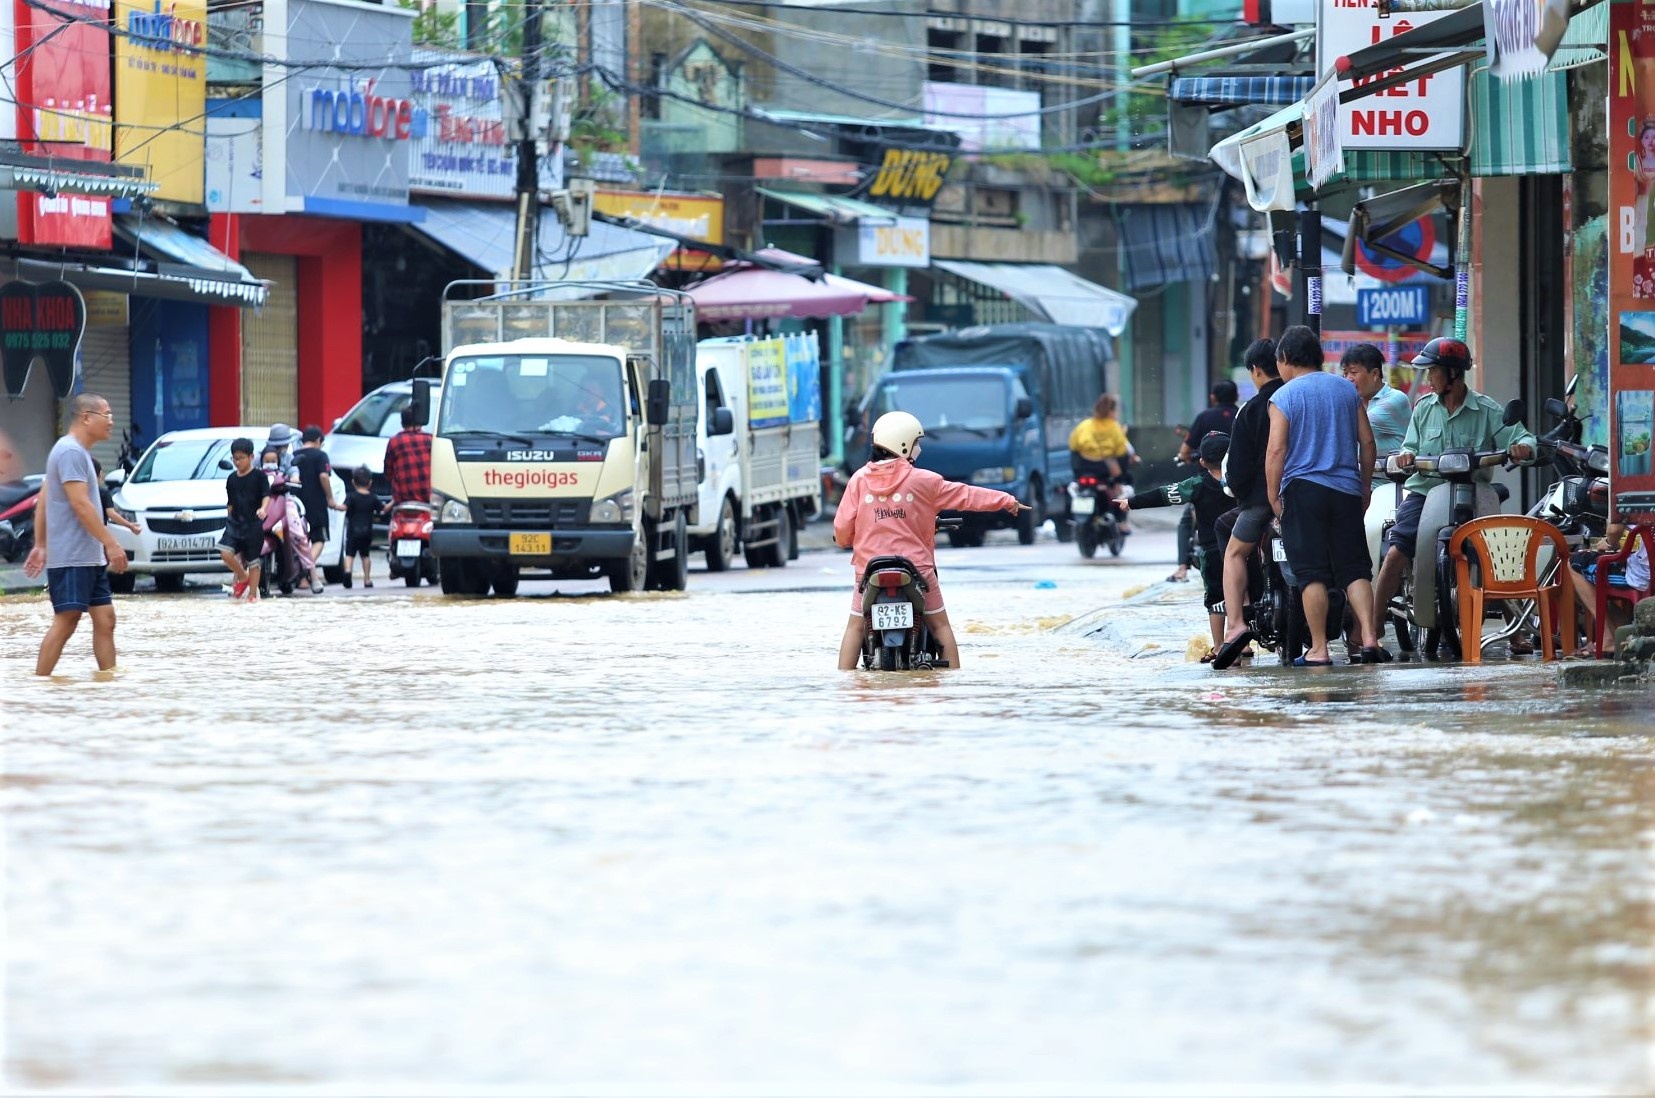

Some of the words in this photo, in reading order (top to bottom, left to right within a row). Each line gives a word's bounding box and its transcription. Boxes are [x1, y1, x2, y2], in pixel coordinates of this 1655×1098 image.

[303, 75, 411, 140] mobifone
[1352, 110, 1429, 136] NHO
[3, 295, 32, 331] NHA
[37, 295, 75, 331] KHOA
[1371, 290, 1415, 319] 200M
[507, 450, 554, 461] ISUZU
[483, 469, 578, 488] thegioigas
[521, 534, 539, 544] 92C
